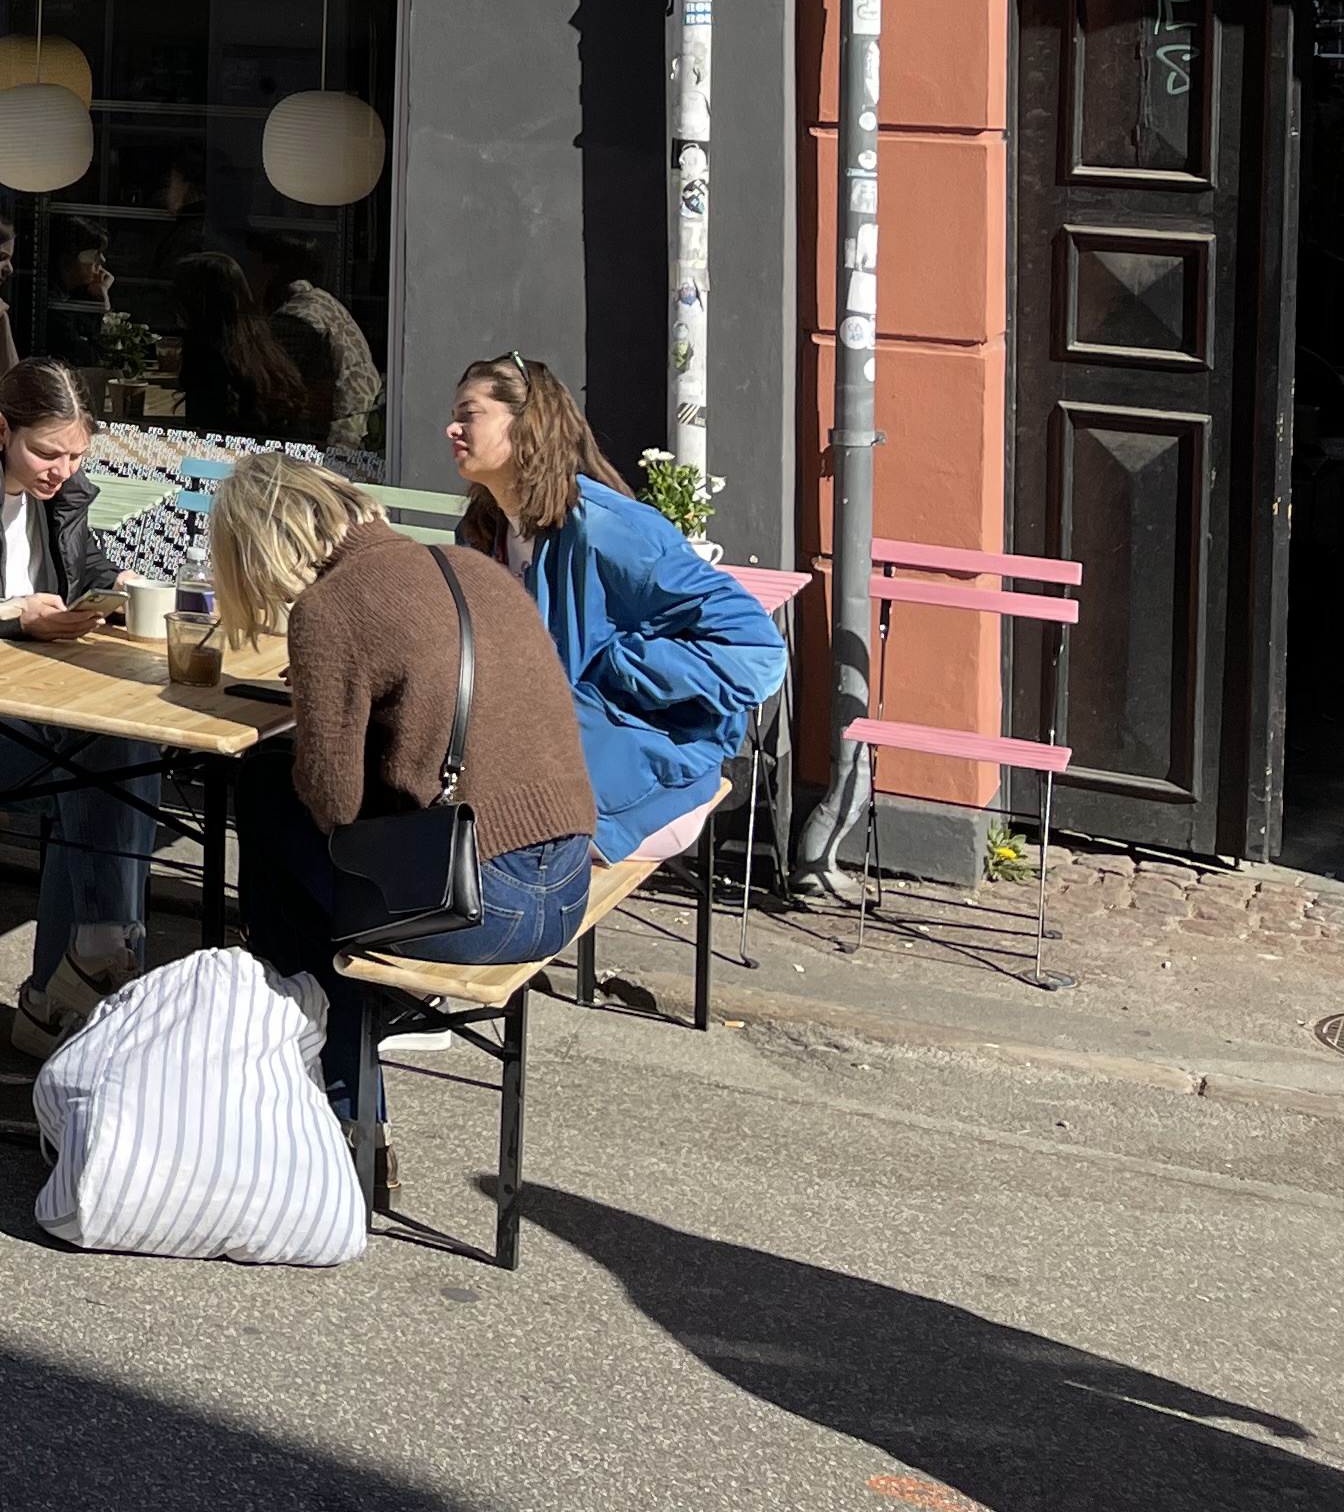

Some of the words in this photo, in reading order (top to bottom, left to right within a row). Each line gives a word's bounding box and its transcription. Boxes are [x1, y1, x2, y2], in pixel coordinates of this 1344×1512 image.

[148, 426, 165, 435] FED.
[206, 433, 223, 442] FED.
[265, 440, 283, 449] FED.
